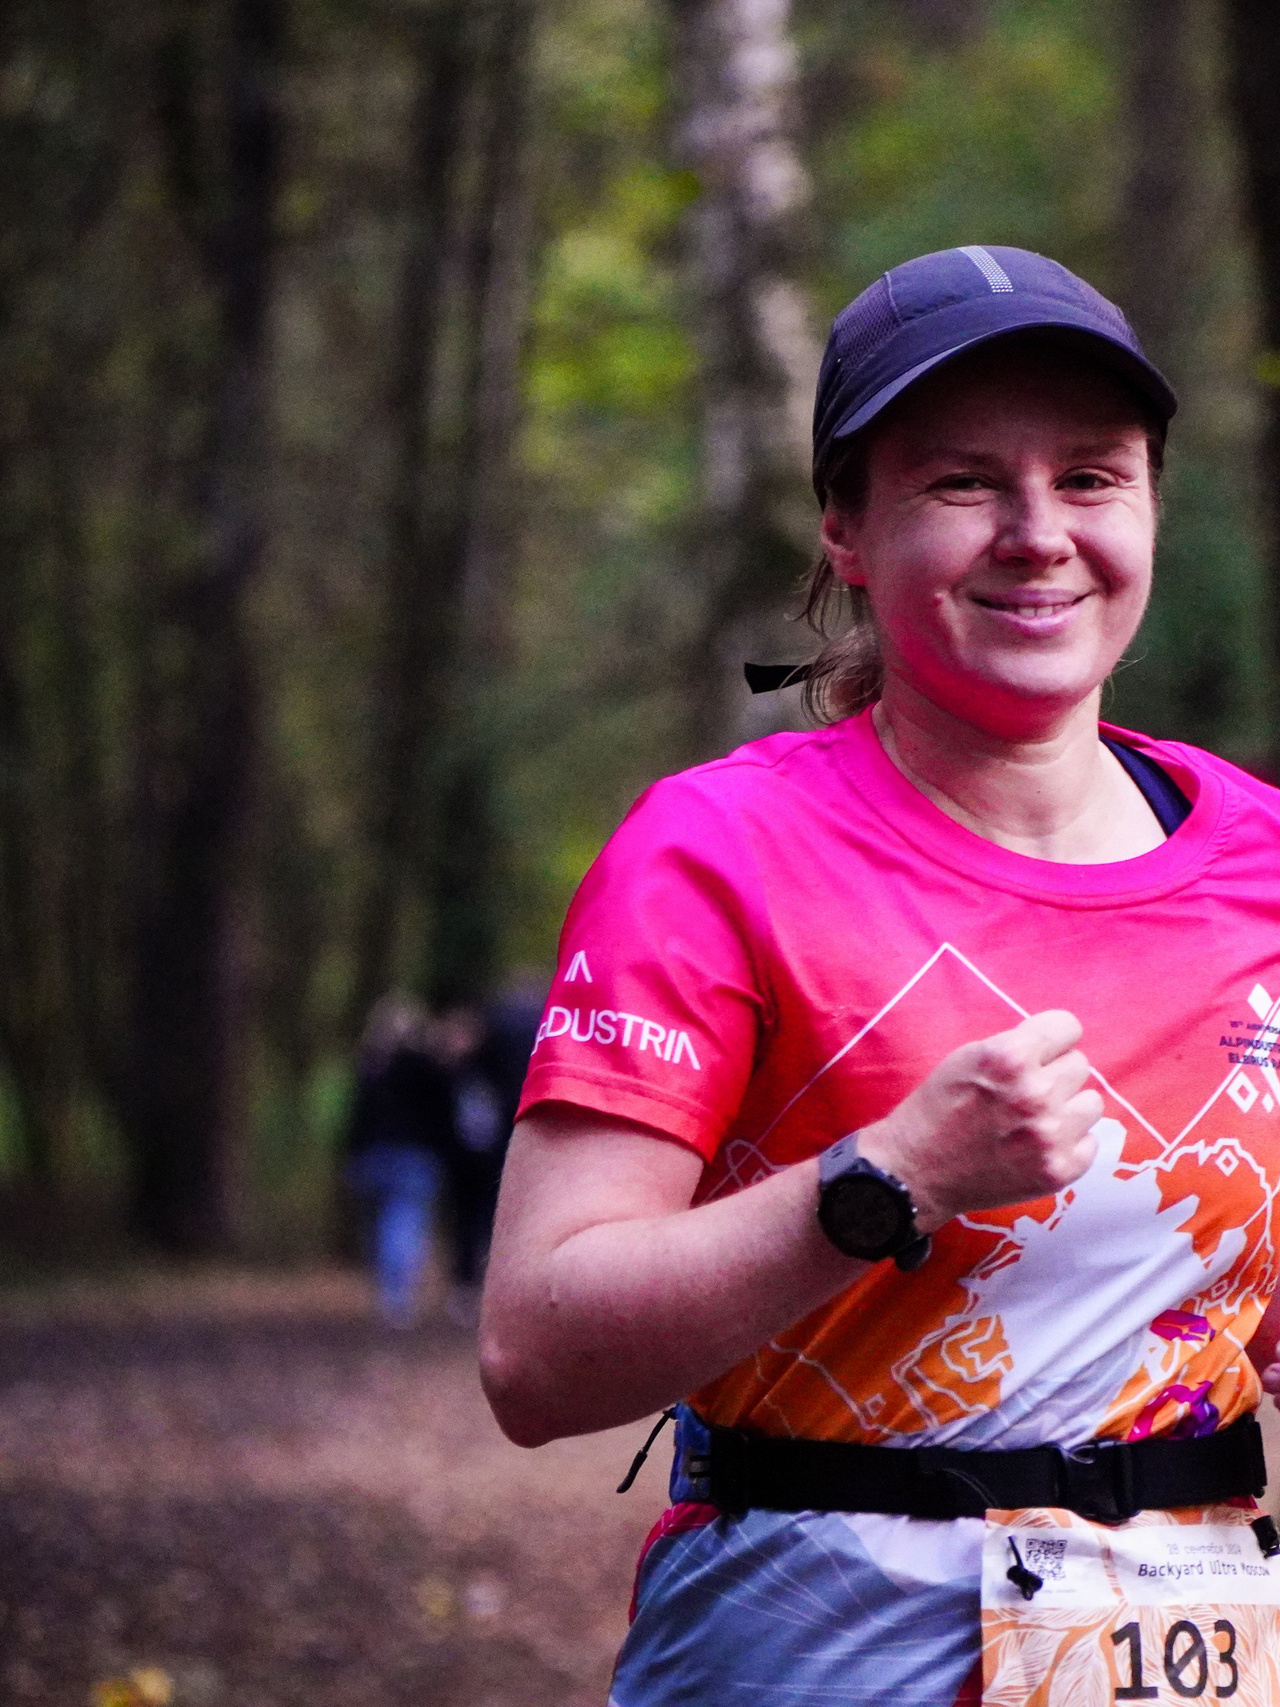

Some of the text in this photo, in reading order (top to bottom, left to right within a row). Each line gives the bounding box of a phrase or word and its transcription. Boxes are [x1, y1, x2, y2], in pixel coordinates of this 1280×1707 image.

[1138, 1560, 1271, 1579] Backyard Ultra Moscow
[1110, 1619, 1239, 1700] 103
